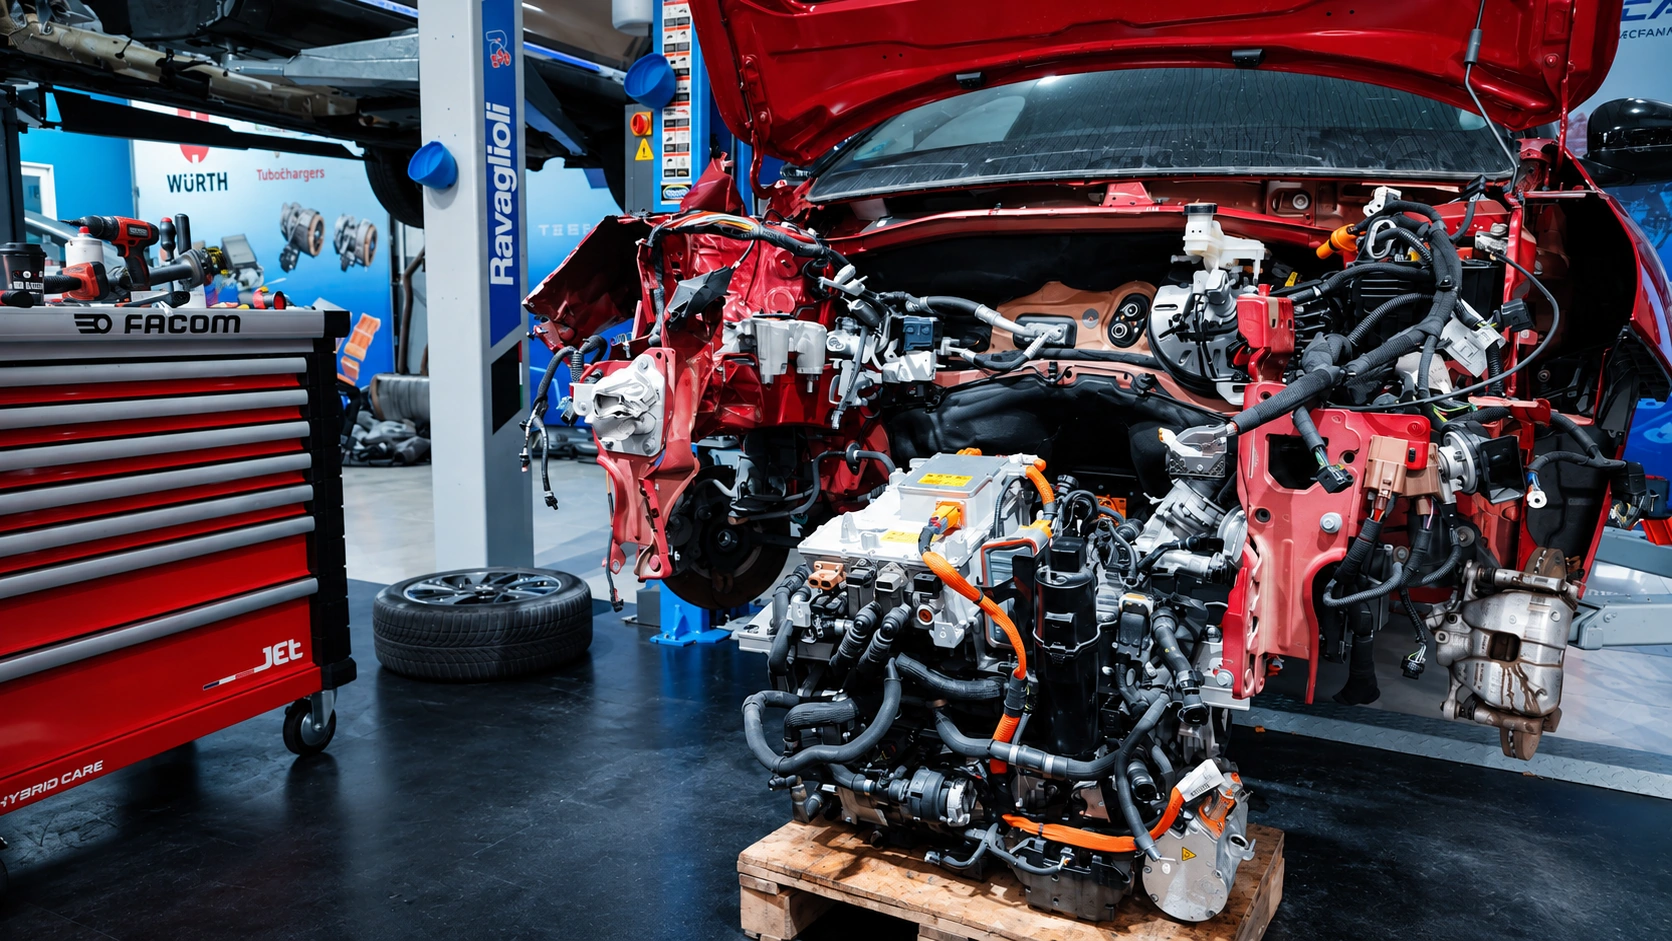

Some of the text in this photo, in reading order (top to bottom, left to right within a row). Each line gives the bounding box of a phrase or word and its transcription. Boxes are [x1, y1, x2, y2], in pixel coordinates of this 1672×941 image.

[485, 102, 518, 286] Ravaglioli
[124, 314, 241, 334] FACOM
[61, 759, 104, 785] CARE
